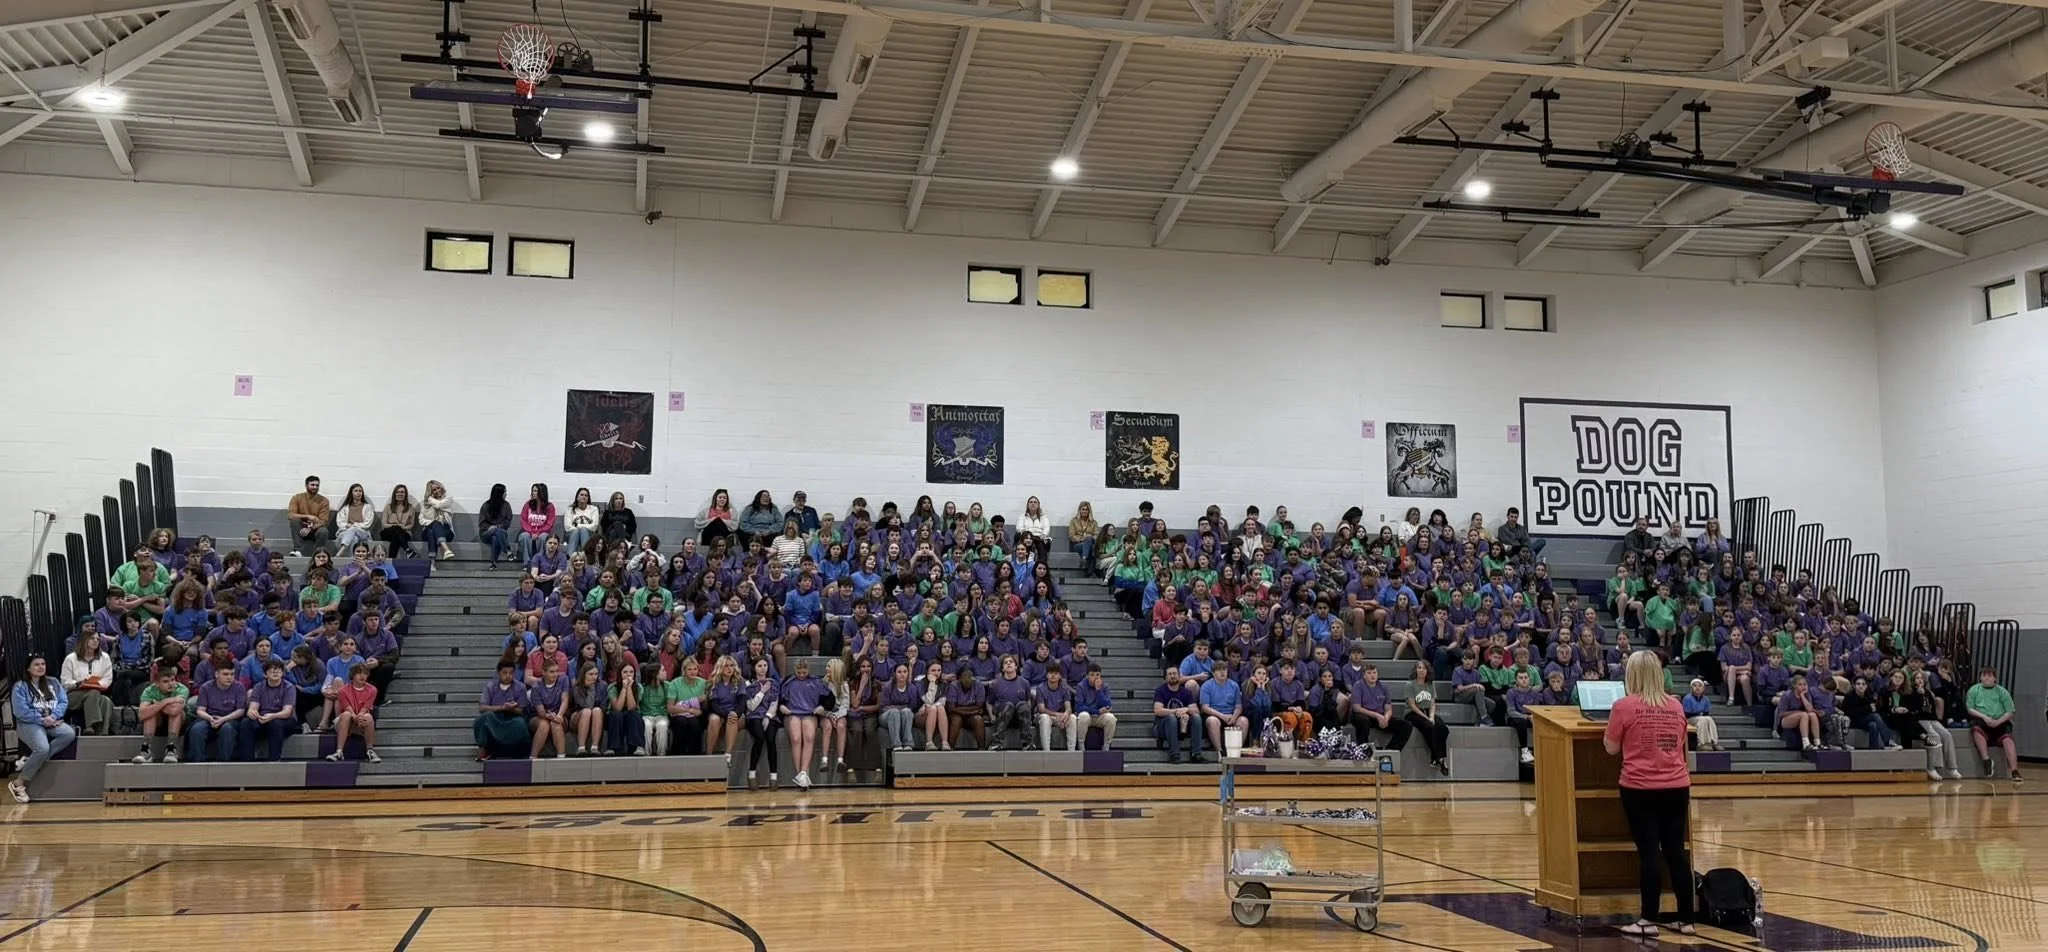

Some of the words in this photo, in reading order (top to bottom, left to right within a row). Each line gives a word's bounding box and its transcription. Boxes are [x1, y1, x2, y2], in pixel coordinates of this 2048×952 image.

[1112, 413, 1173, 427] Secundum
[1394, 424, 1447, 441] Officium
[1571, 415, 1682, 477] DOG
[1533, 476, 1719, 528] POUND
[401, 808, 1152, 832] Bulldogs
